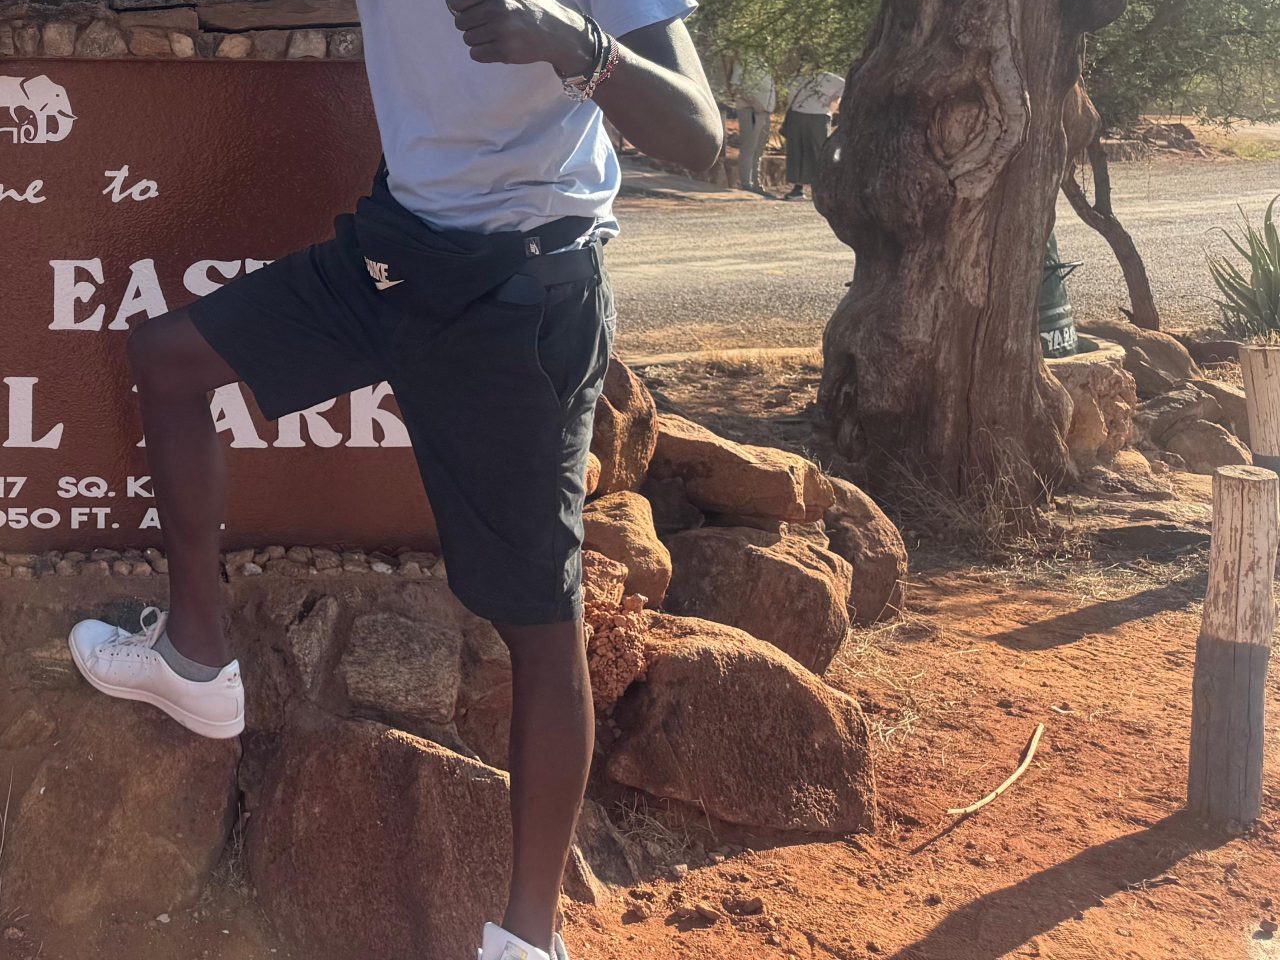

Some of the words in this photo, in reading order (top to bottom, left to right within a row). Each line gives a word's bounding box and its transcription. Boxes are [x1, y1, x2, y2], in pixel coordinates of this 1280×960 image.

[102, 164, 160, 203] to
[131, 380, 413, 449] ARK
[57, 476, 116, 499] SQ.
[70, 507, 120, 529] FT.
